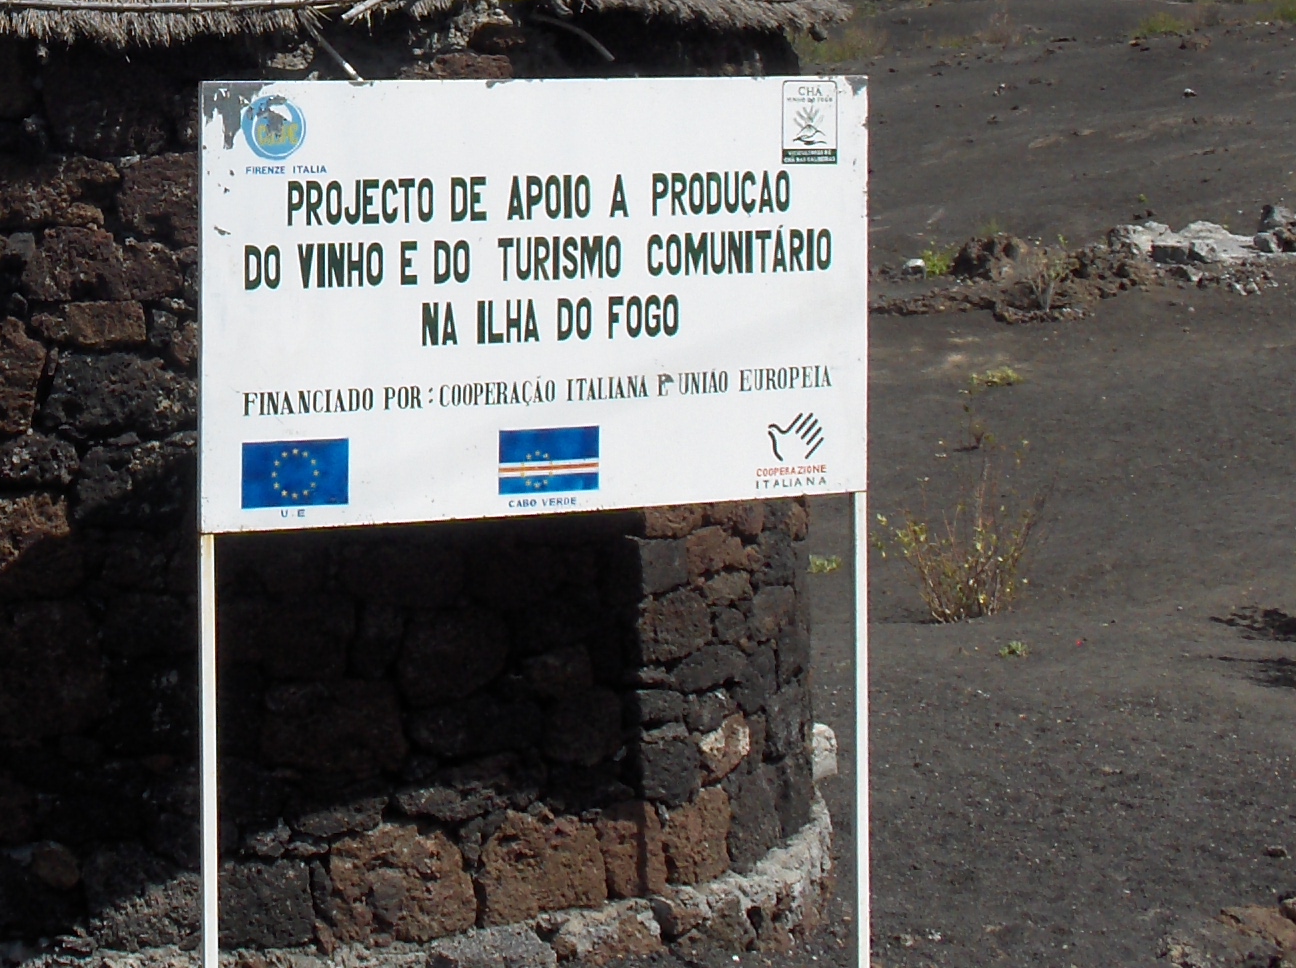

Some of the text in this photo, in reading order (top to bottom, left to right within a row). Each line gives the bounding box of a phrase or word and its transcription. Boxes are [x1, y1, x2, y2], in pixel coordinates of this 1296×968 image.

[245, 164, 328, 175] FIRENZE ITALIA
[287, 178, 434, 227] PROJECTO
[450, 176, 487, 222] DE
[507, 174, 591, 220] APOIO
[609, 174, 629, 218] A
[244, 224, 833, 290] DO VINHO E DO TURISMO COMUNITÁRIO
[421, 294, 680, 347] NA ILHA DO FOGO
[242, 387, 374, 417] FINANCIADO
[566, 374, 649, 402] ITALIANA
[738, 364, 832, 393] EUROPEIA
[755, 464, 827, 478] COOPERAZIONE
[755, 476, 827, 490] ITALIANA
[508, 496, 577, 508] CABO VERDE
